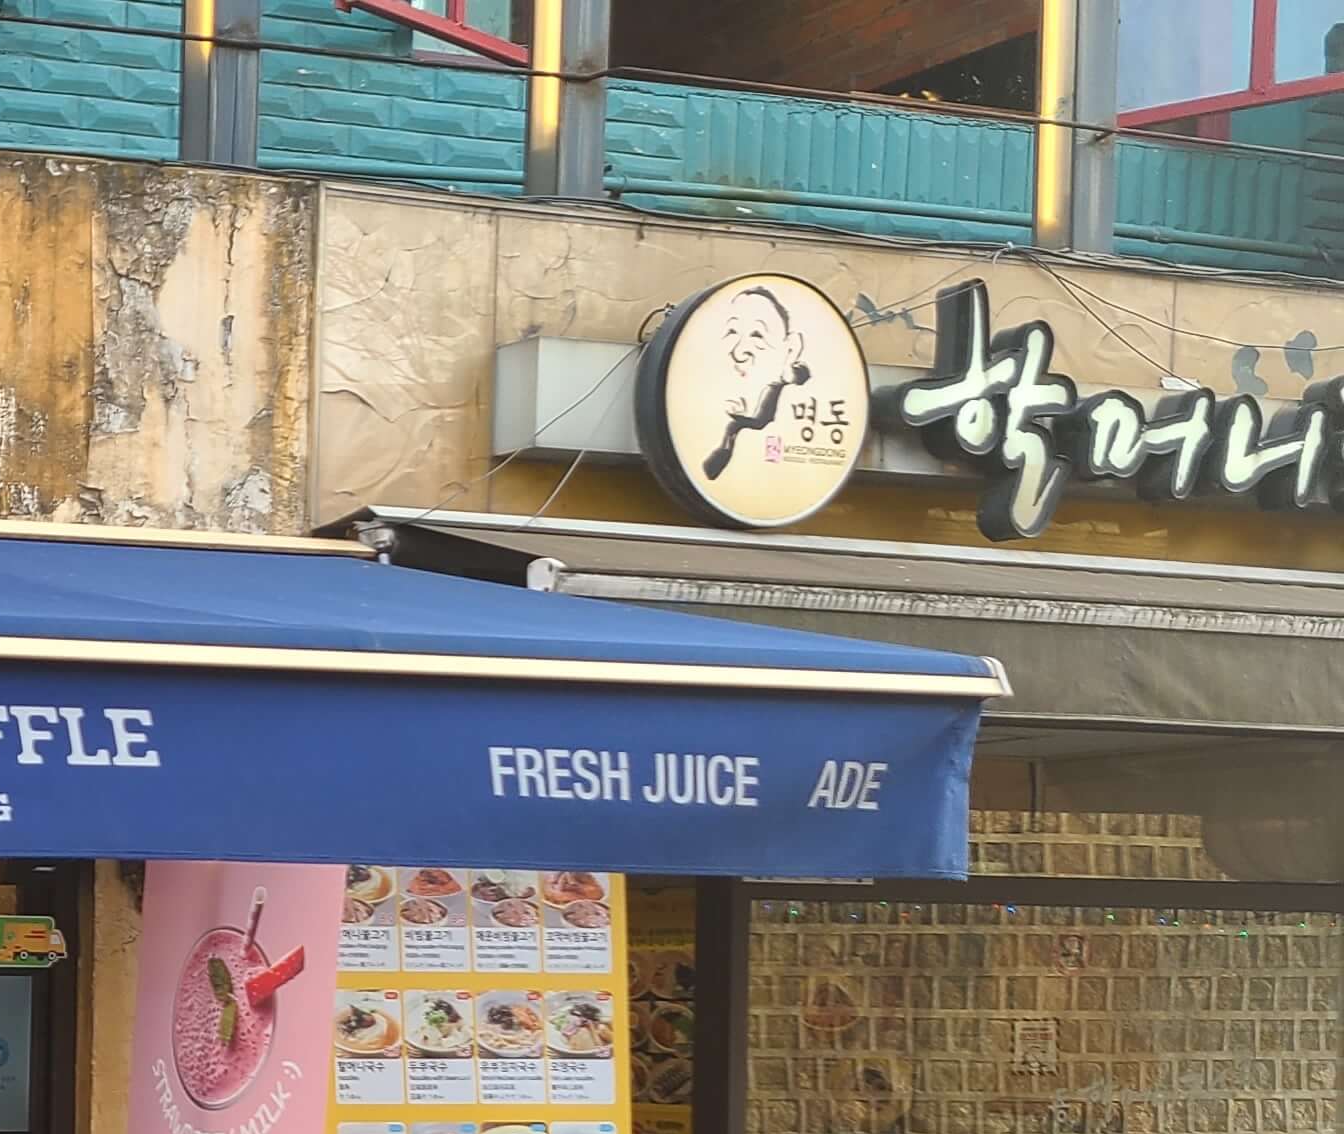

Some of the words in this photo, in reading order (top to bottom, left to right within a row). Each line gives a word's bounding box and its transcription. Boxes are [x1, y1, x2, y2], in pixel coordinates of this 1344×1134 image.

[791, 396, 850, 445] 명동
[487, 745, 631, 802] FRESH
[642, 751, 761, 808] JUICE
[807, 759, 889, 812] ADE
